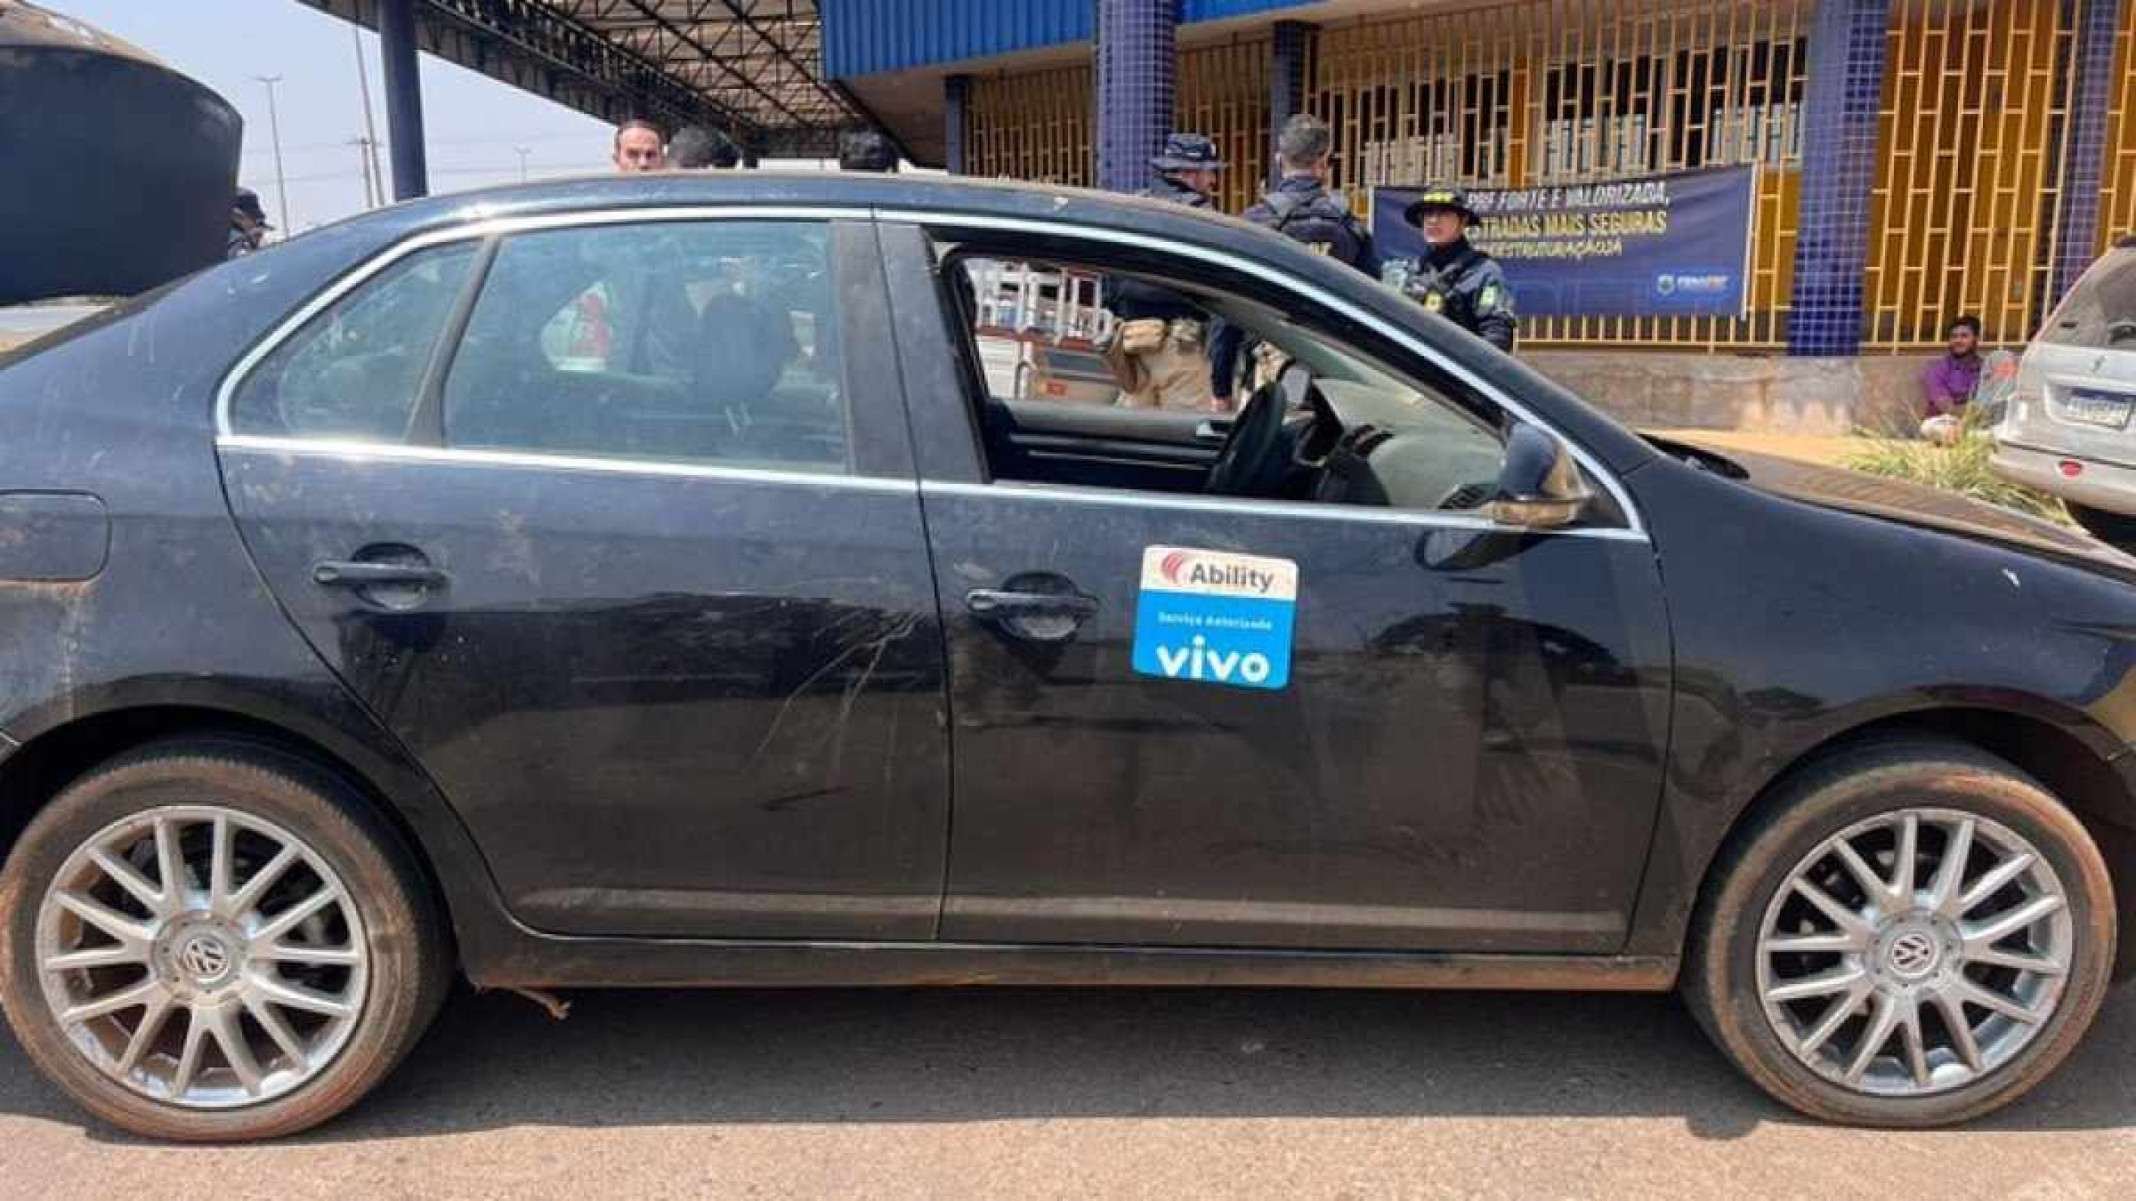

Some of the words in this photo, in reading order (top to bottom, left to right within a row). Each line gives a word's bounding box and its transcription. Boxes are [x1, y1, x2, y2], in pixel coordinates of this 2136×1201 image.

[1498, 189, 1547, 210] FORTE
[1551, 187, 1562, 208] E
[1566, 181, 1670, 208] VALORIZADA,
[1545, 213, 1585, 237] MAIS
[1589, 210, 1667, 235] SEGURAS
[1190, 563, 1274, 593] Ability
[1158, 611, 1202, 627] Serviço
[1205, 615, 1272, 631] Autorizado
[1156, 634, 1270, 683] vivo
